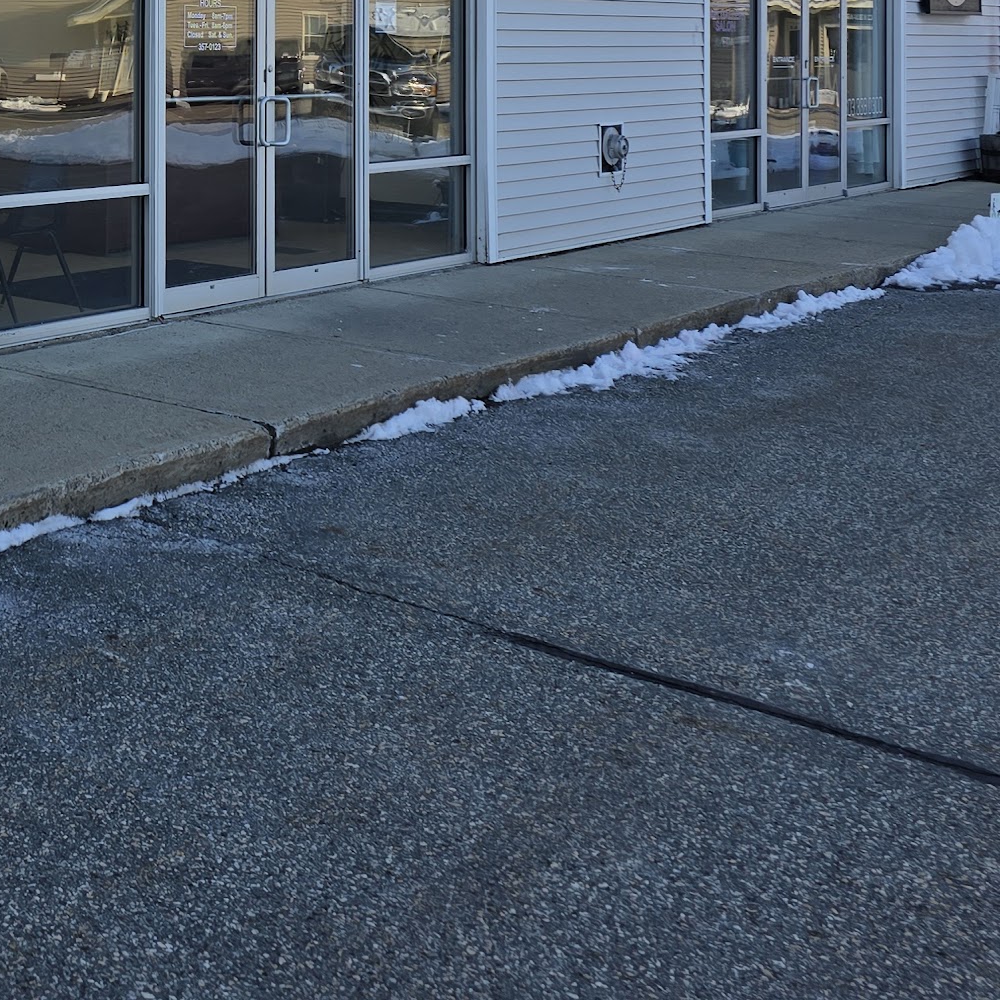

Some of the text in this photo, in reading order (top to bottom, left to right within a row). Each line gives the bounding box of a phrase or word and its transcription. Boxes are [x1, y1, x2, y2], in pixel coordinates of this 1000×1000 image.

[187, 11, 206, 20] Monday
[187, 31, 204, 39] Closed
[198, 42, 221, 51] 357-0123
